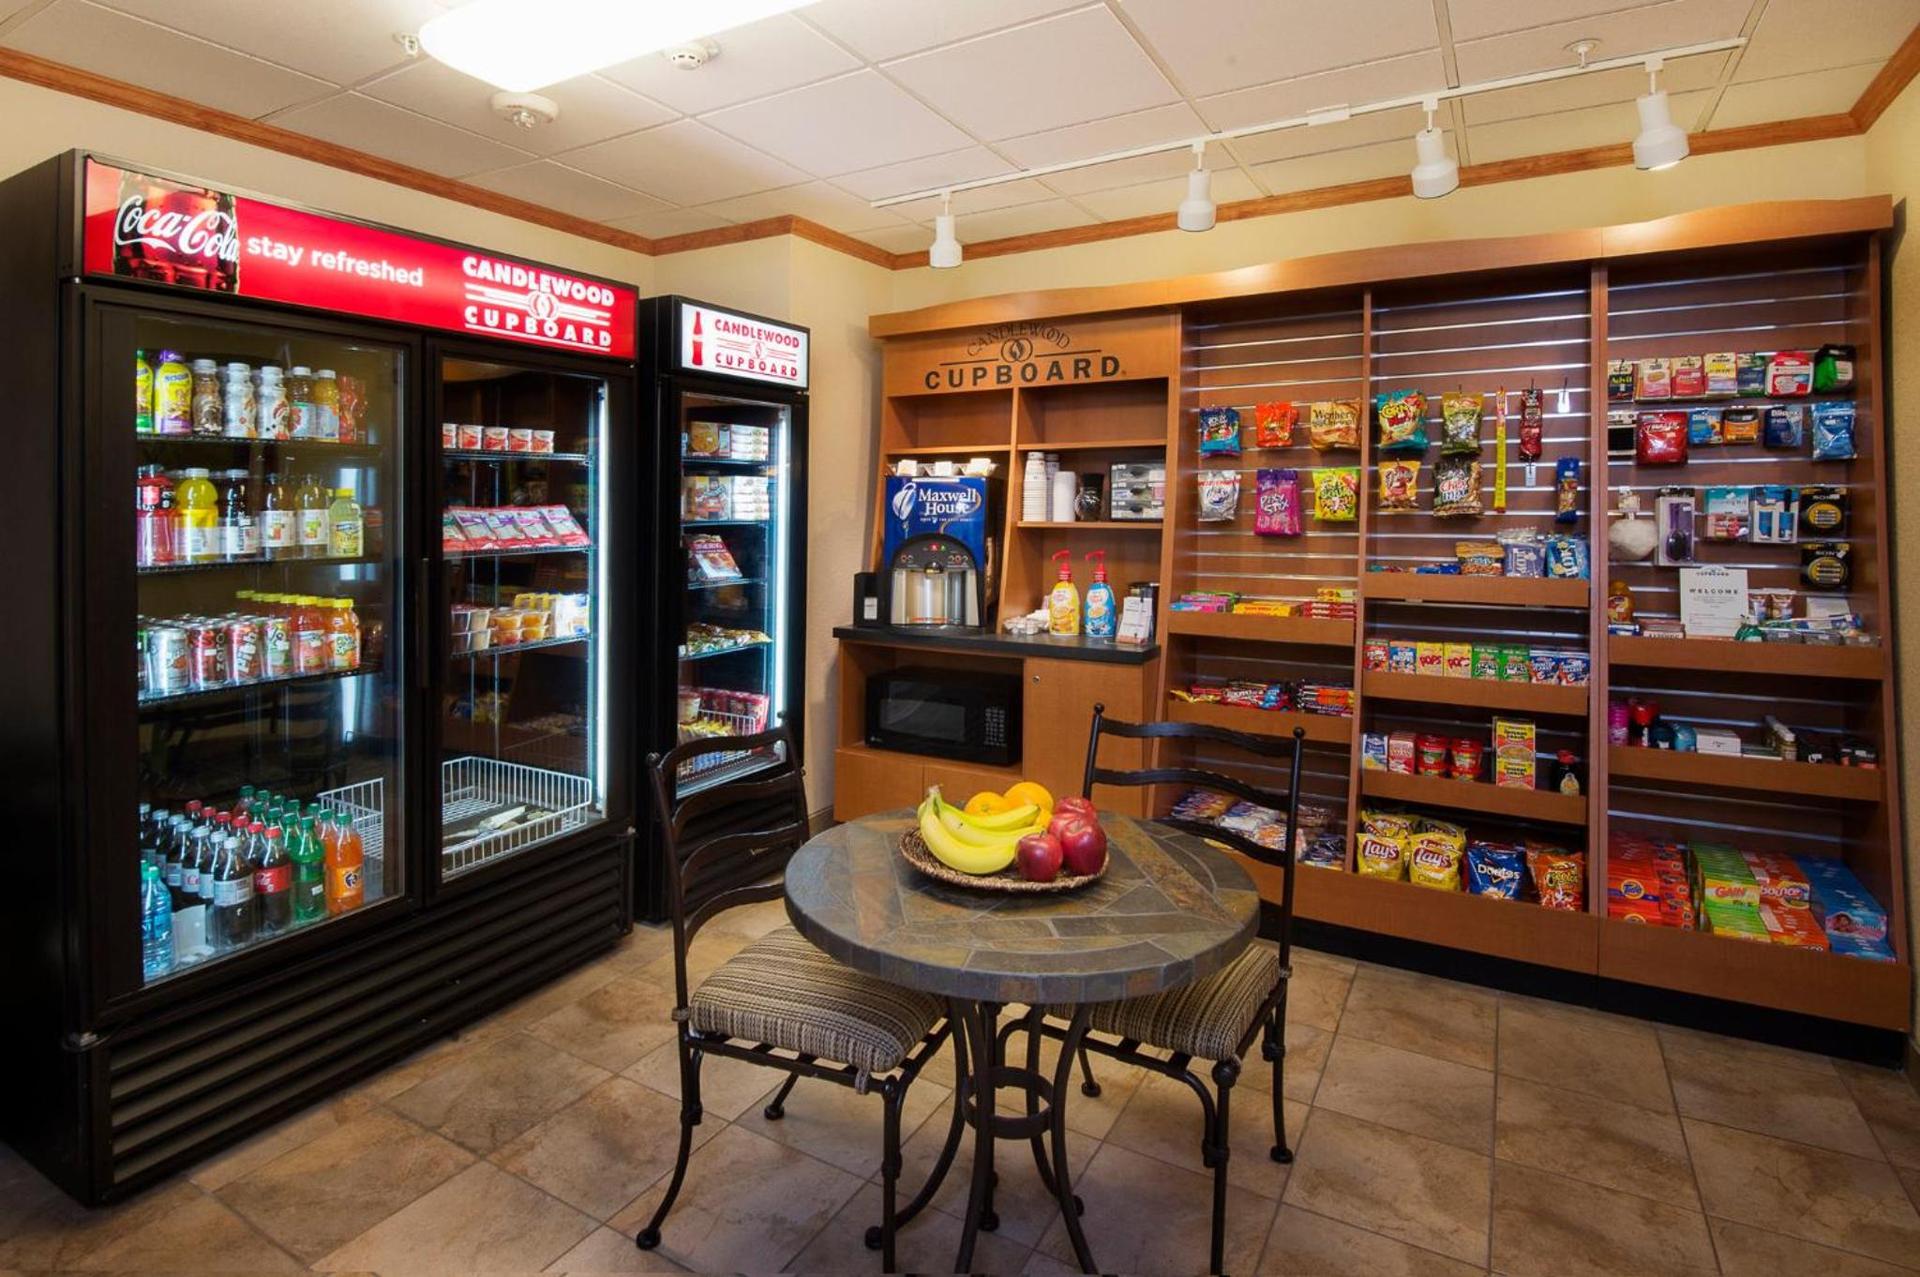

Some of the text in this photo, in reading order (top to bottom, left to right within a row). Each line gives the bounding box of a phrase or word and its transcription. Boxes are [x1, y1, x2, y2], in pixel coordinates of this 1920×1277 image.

[114, 195, 240, 262] Coca-Cola
[247, 236, 423, 288] stay refreshed
[462, 256, 615, 307] CANDLEWOOD
[464, 305, 612, 347] CUPBOARD
[714, 319, 800, 349] CANDLEWOOD
[966, 321, 1071, 357] CANDLEWOOD
[715, 352, 798, 378] CUPBOARD
[924, 355, 1121, 390] CUPBOARD
[918, 488, 977, 503] Maxwell
[924, 501, 971, 516] House
[236, 631, 258, 674] Pibb
[1477, 863, 1521, 881] Doritos
